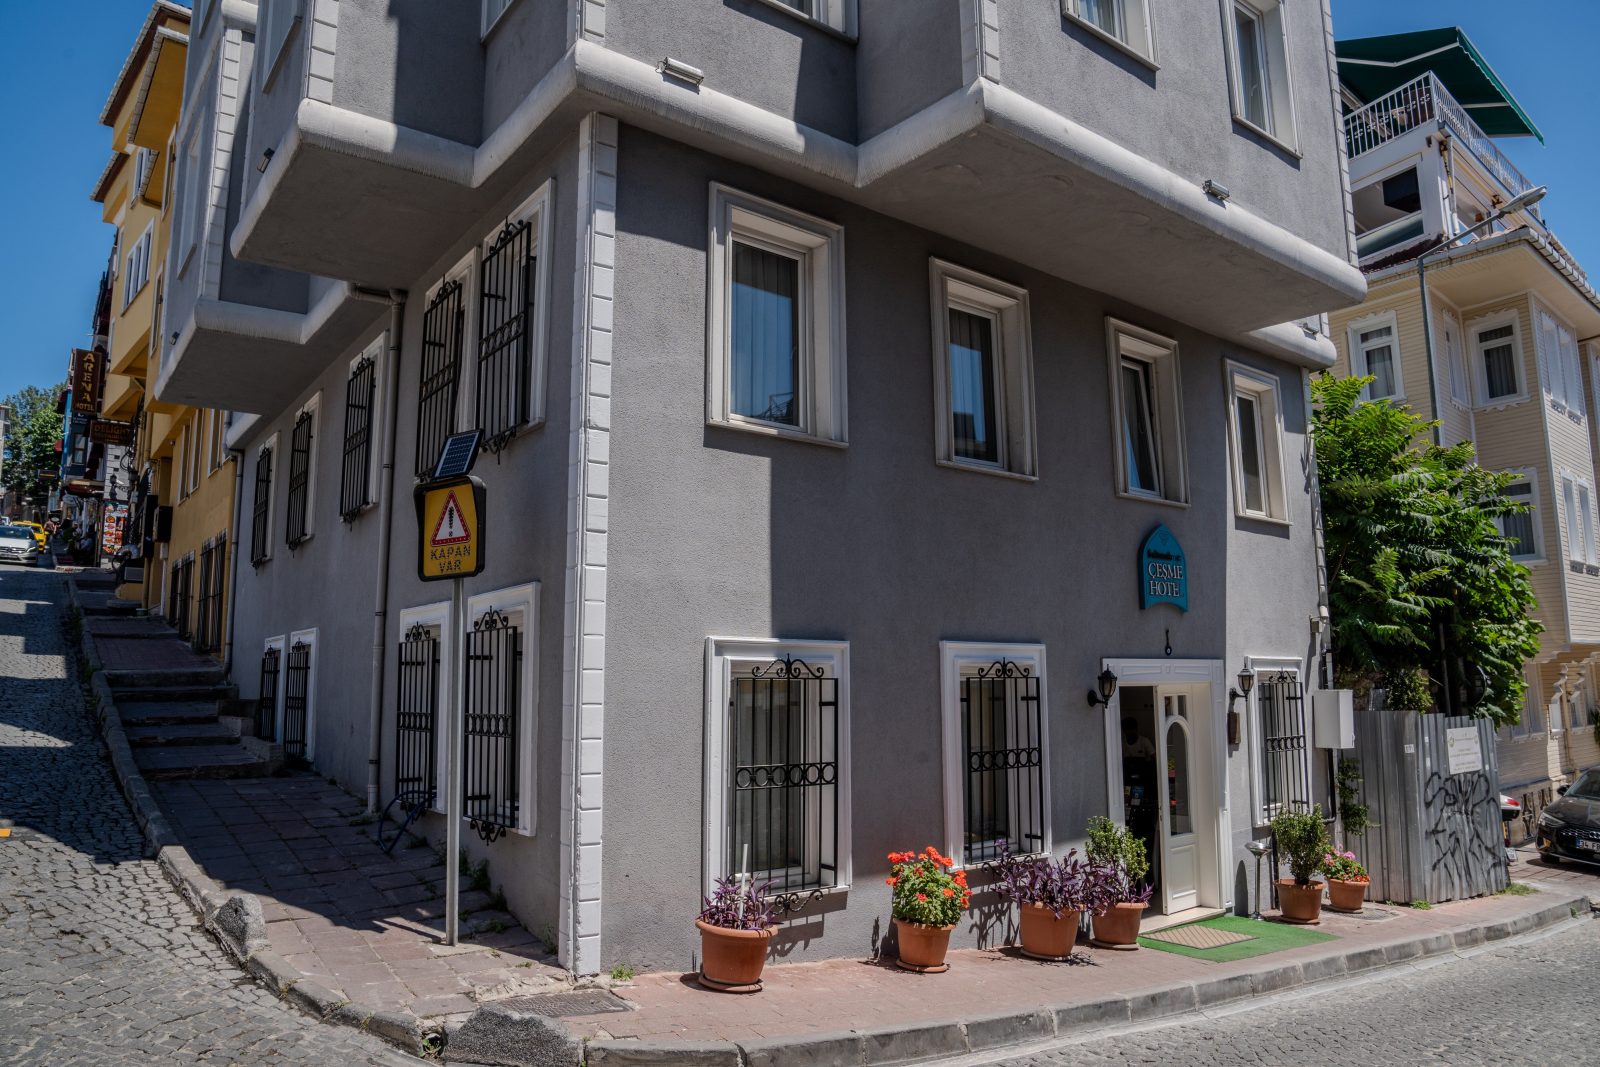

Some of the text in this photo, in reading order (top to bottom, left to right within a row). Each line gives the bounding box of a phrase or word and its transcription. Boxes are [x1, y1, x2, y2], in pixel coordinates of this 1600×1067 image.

[82, 353, 95, 402] ARENA
[75, 403, 94, 411] HOTEL
[430, 545, 471, 560] KAPAN
[439, 560, 461, 573] VAR
[1148, 562, 1184, 580] ÇEŞME
